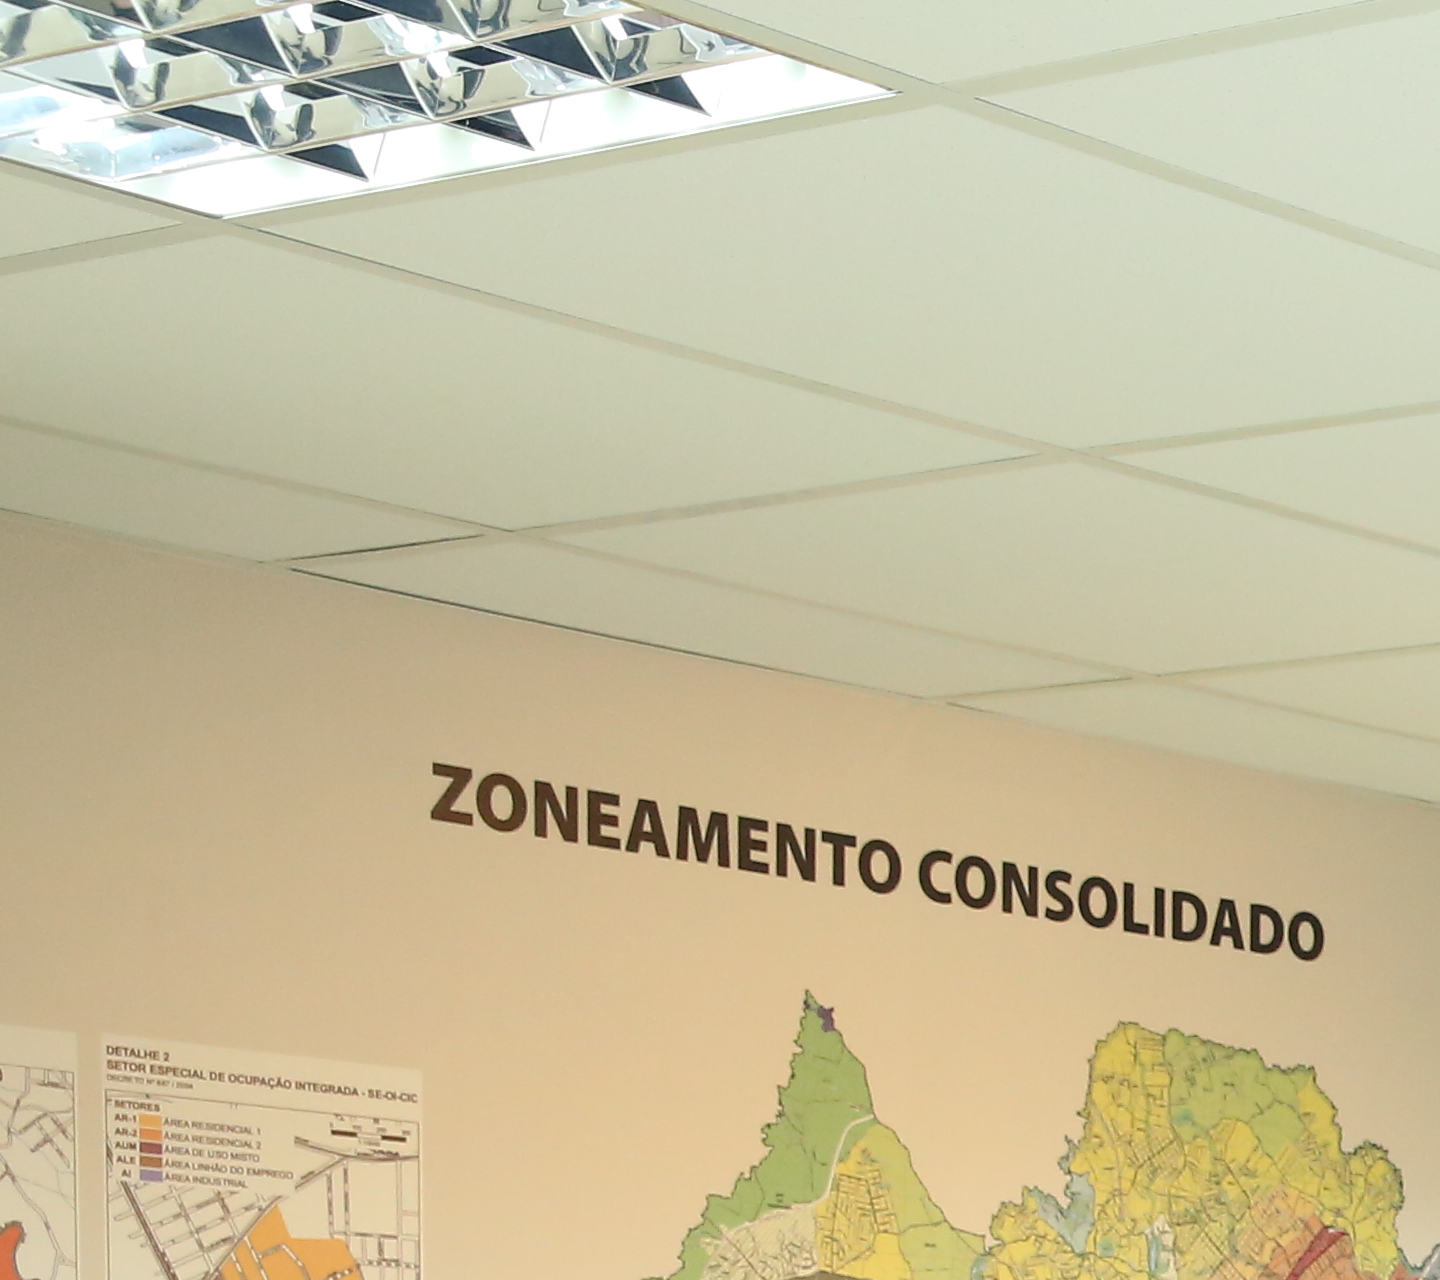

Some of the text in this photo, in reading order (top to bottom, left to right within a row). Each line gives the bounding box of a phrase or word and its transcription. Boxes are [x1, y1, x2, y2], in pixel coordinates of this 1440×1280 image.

[430, 762, 1326, 962] ZONEAMENTO CONSOLIDADO
[106, 1045, 170, 1062] DETALHE 2
[107, 1060, 147, 1074] SETOR
[150, 1064, 206, 1081] ESPECIAL
[210, 1071, 225, 1082] DE
[228, 1073, 292, 1090] OCUPAÇÃO
[295, 1081, 359, 1097] INTEGRADA
